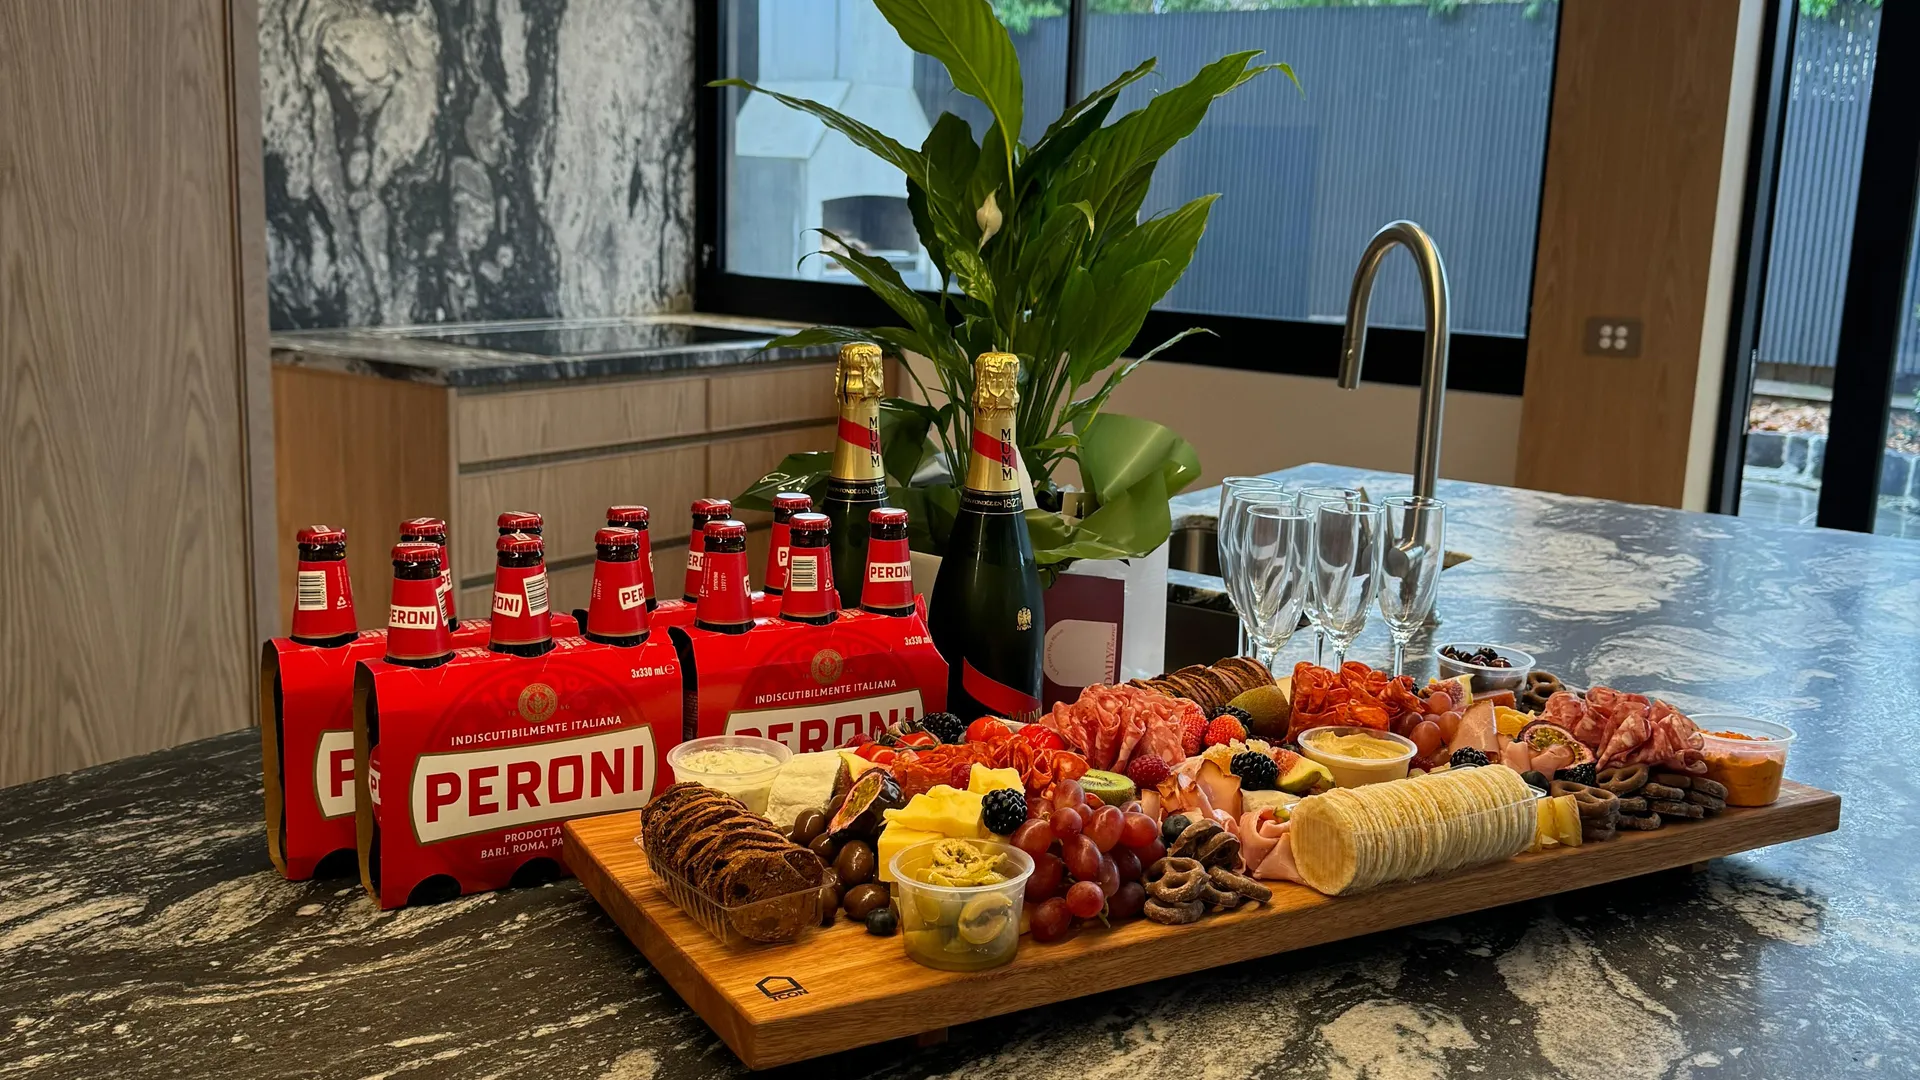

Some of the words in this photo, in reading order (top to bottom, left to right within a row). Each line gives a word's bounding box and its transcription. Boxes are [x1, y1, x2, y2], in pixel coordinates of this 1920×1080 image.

[869, 416, 881, 468] MUMM
[1001, 428, 1013, 481] MUMM
[390, 608, 435, 625] ERONI
[631, 666, 653, 679] 3x330
[755, 684, 851, 704] INDISCUTIBILMENTE
[854, 679, 897, 692] ITALIANA
[451, 722, 568, 746] INDISCUTIBILMENTE
[571, 715, 622, 731] ITALIANA
[426, 745, 644, 824] PERONI
[504, 826, 562, 843] PRODOTTA
[481, 846, 509, 859] BARI,
[513, 841, 548, 853] ROMA,
